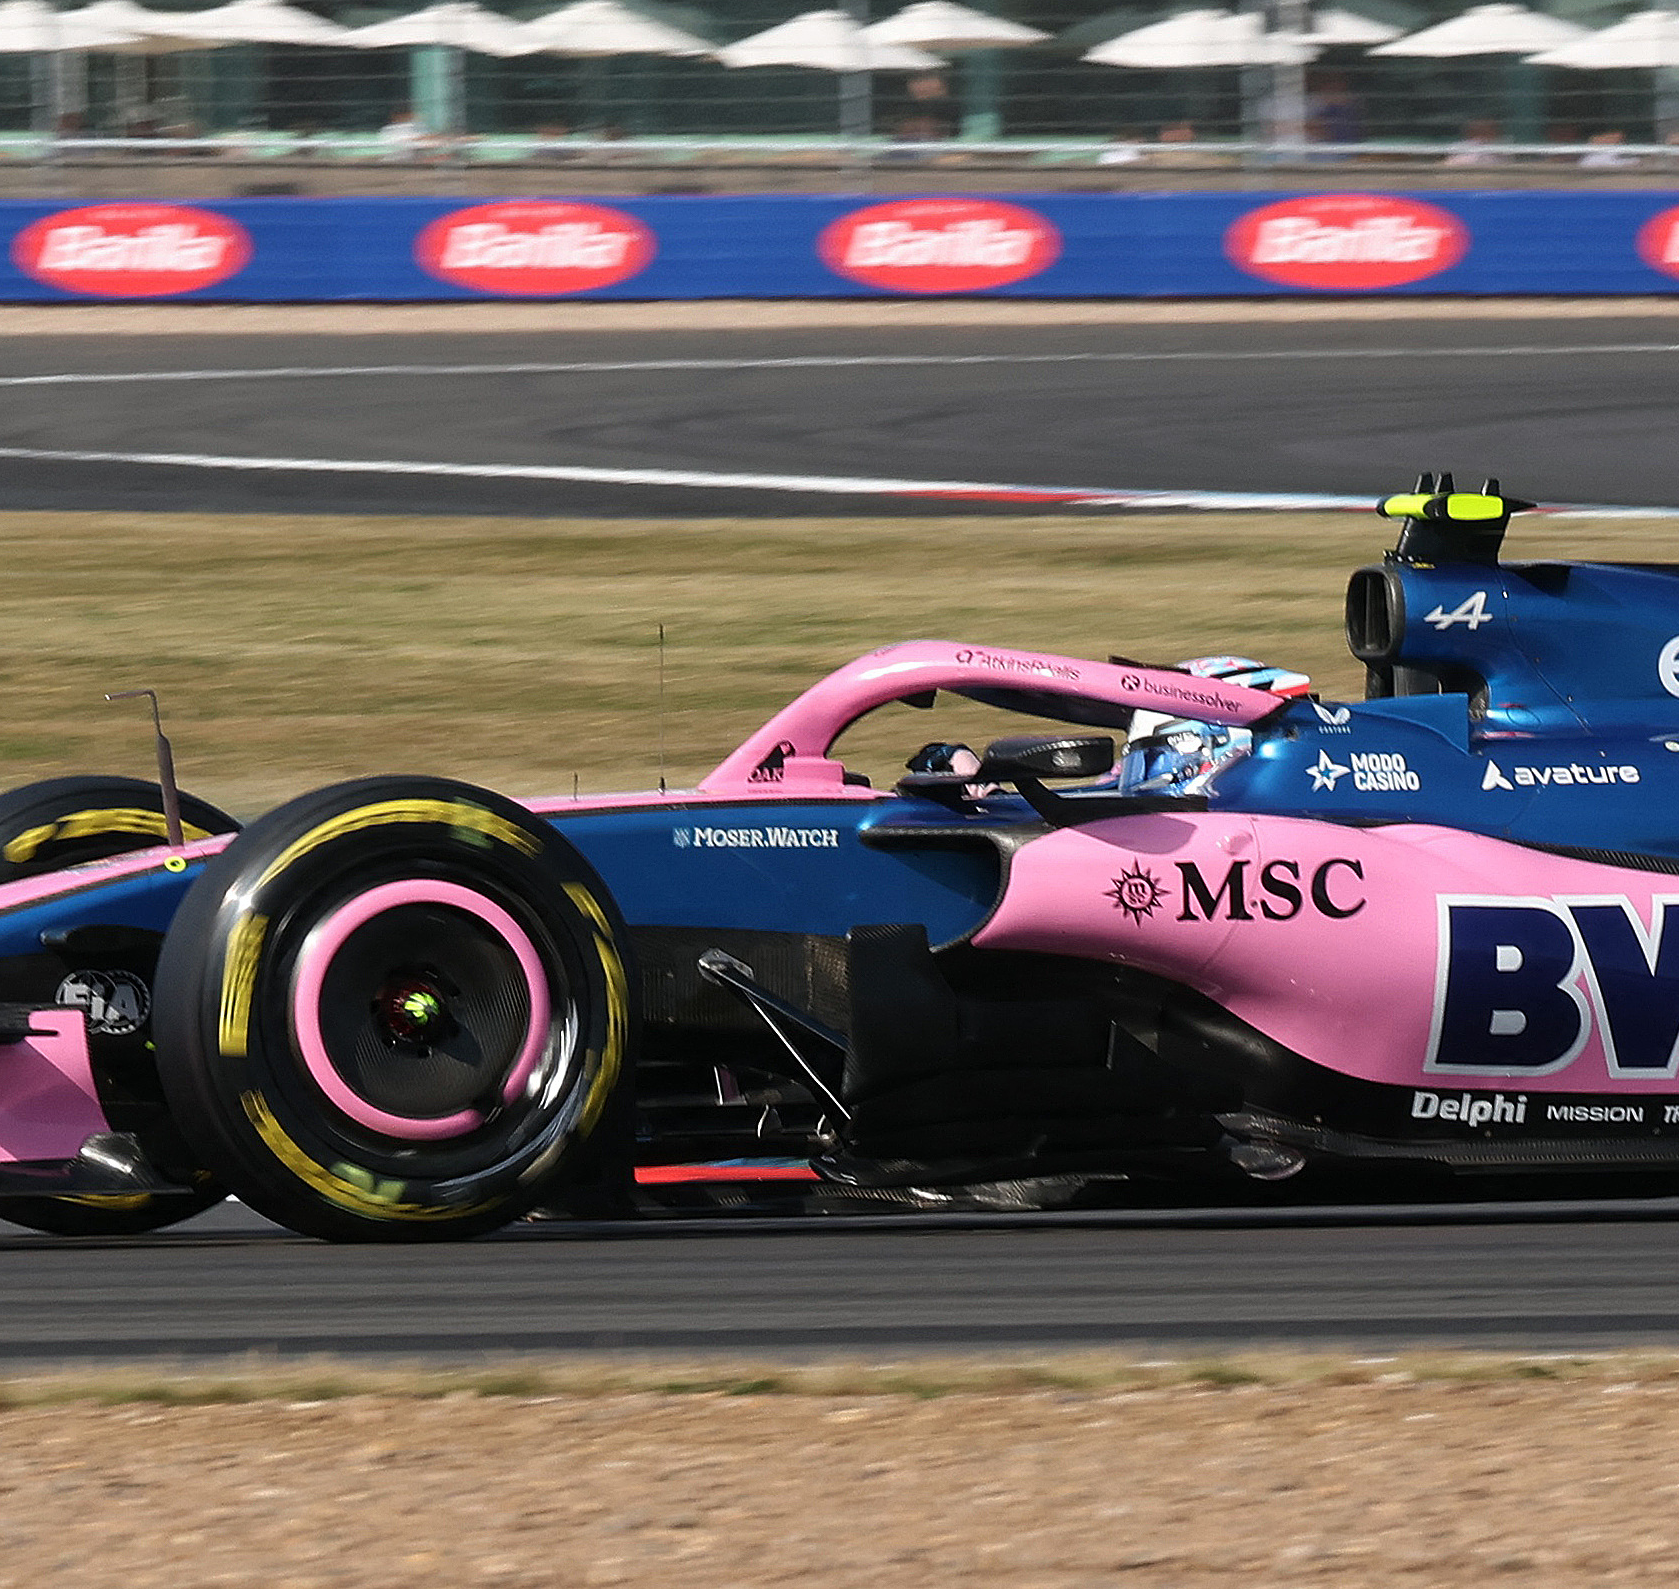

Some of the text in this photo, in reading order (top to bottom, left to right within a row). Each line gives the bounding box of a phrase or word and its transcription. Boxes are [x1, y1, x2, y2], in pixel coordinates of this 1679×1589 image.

[1143, 679, 1242, 713] businessolver
[1350, 752, 1407, 772] MODO
[1354, 771, 1421, 791] CASINO
[1514, 763, 1640, 786] avature
[1174, 858, 1366, 922] MSC
[1411, 1091, 1527, 1127] Delphi
[1547, 1105, 1644, 1123] MISSION
